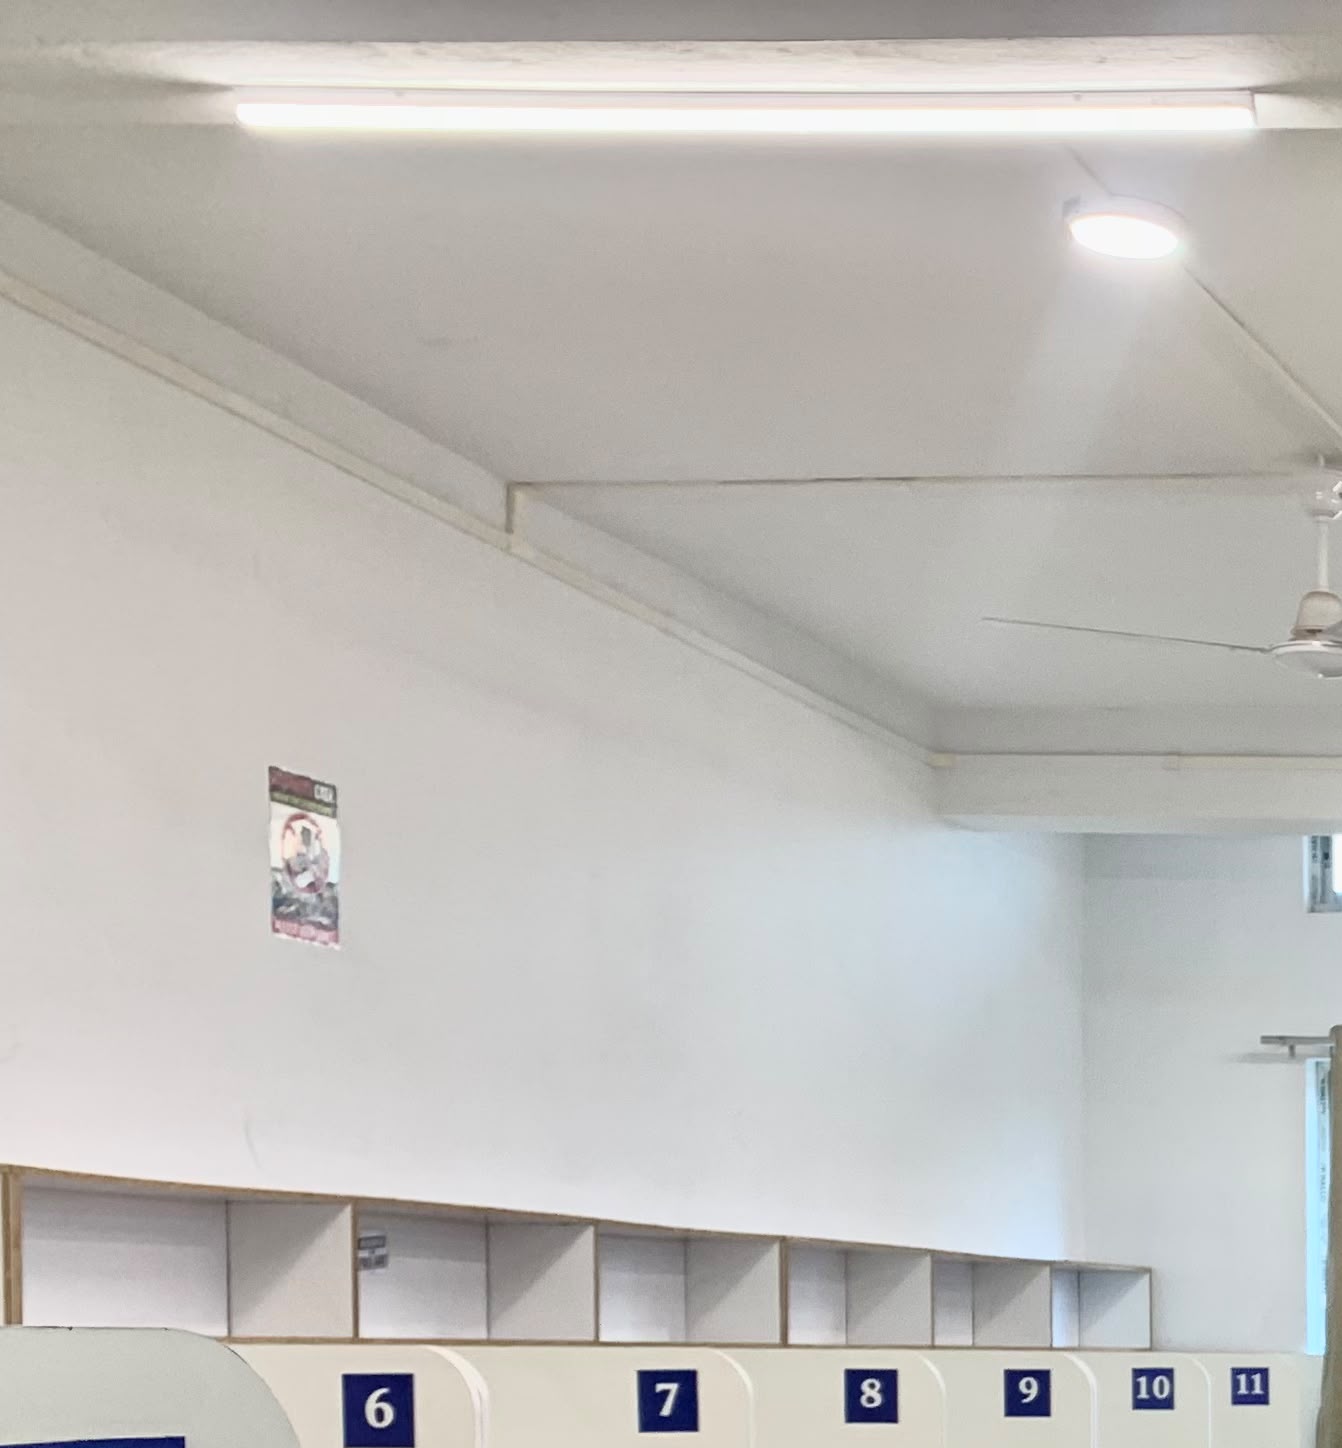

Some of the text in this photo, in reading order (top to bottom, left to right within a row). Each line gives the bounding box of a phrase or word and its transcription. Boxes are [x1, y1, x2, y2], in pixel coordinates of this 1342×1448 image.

[860, 1378, 883, 1408] 8
[1018, 1377, 1040, 1403] 9
[1136, 1375, 1171, 1400] 10
[1236, 1372, 1265, 1396] 11
[364, 1388, 395, 1429] 6
[654, 1381, 681, 1418] 7
